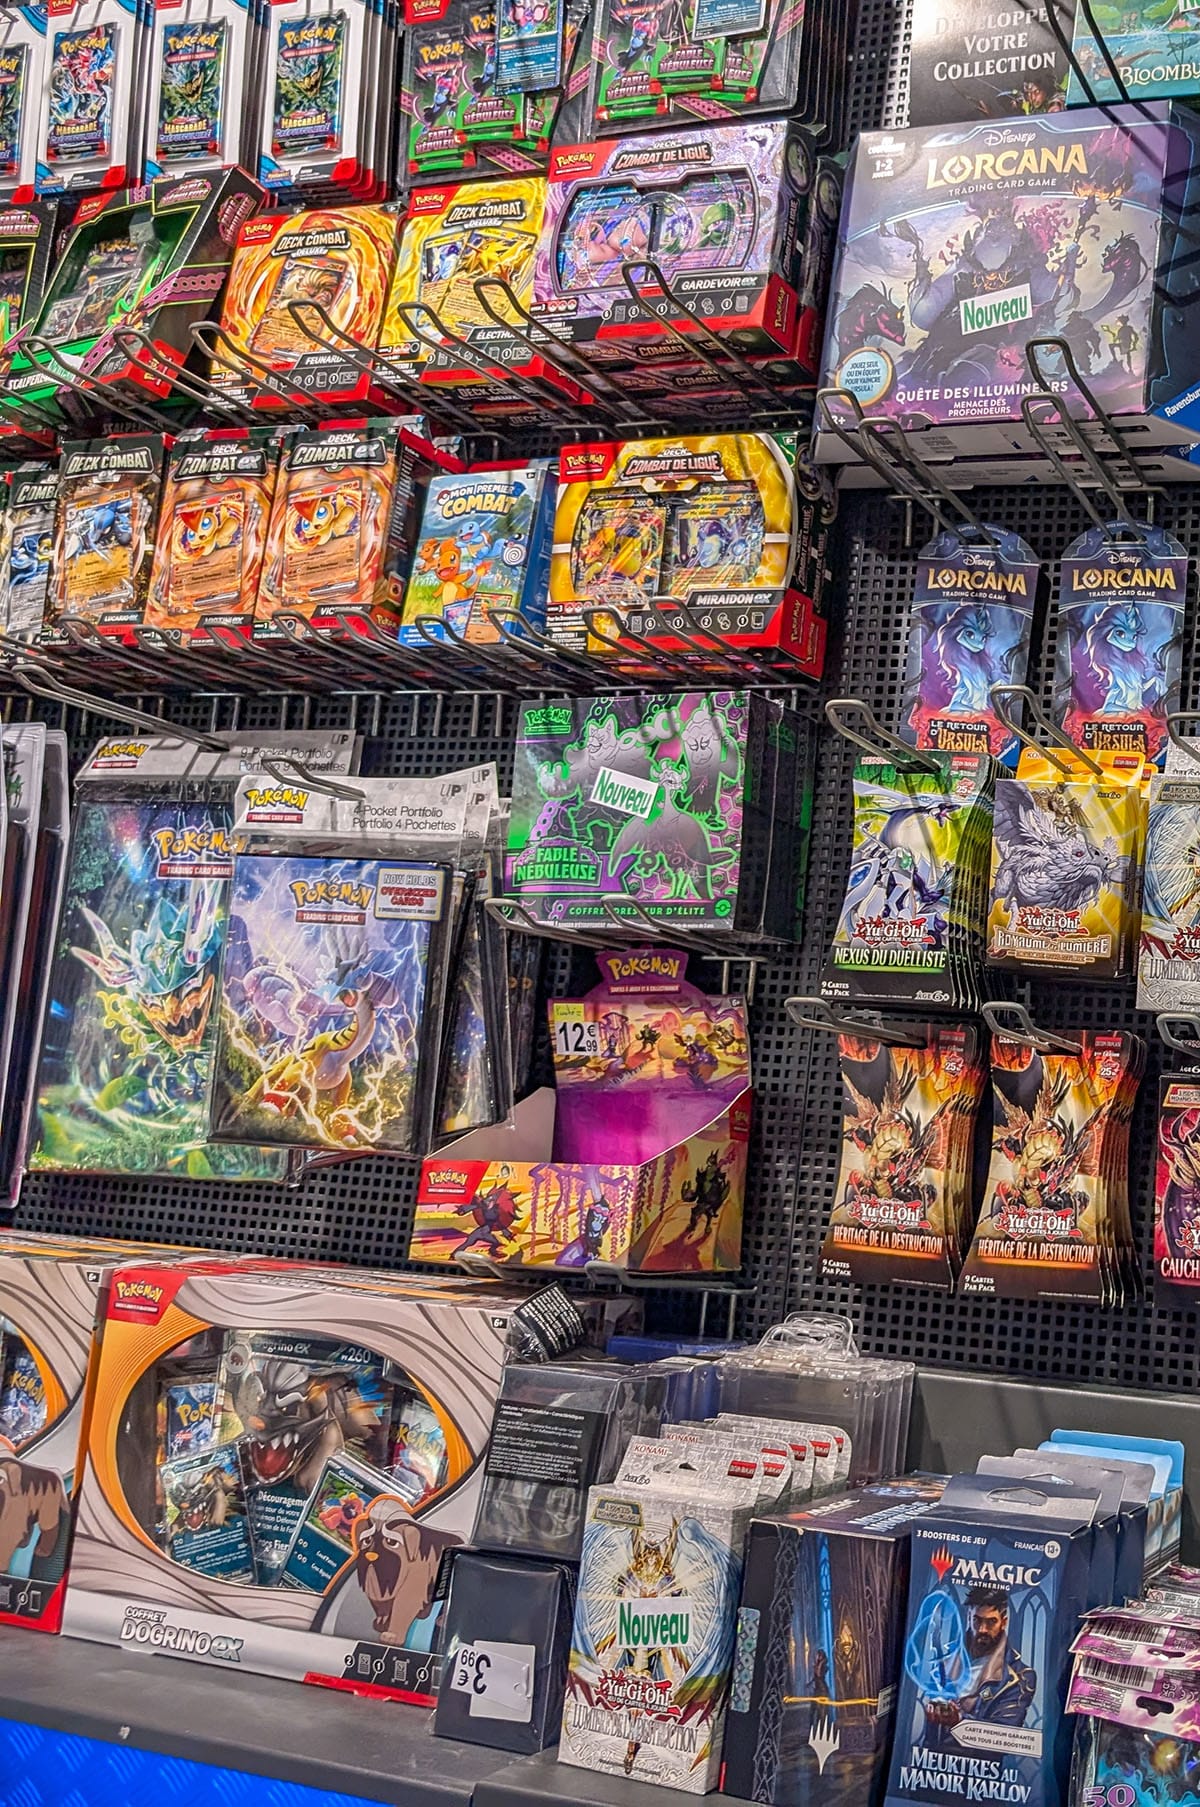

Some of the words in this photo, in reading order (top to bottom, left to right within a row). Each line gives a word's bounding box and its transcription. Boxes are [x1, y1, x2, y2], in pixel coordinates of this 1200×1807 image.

[963, 32, 1028, 54] VOTRE
[676, 48, 703, 61] FABLE
[933, 51, 1057, 81] COLLECTION
[984, 129, 1036, 146] Disney
[615, 150, 660, 170] COMBAT
[661, 149, 678, 163] DE
[678, 143, 712, 162] LIGUE
[927, 143, 1088, 190] LORCANA
[949, 183, 993, 196] TRADING
[997, 180, 1024, 190] CARD
[1028, 178, 1057, 188] GAME
[450, 205, 483, 222] DECK
[485, 201, 521, 218] COMBAT
[280, 233, 310, 251] DECK
[311, 230, 347, 247] COMBAT
[680, 277, 741, 291] GARDEVOIR
[963, 294, 1028, 328] Nouveau
[895, 386, 940, 404] QUÊTE
[943, 385, 971, 399] DES
[953, 401, 985, 409] MENACE
[987, 399, 1006, 407] DES
[948, 405, 1011, 416] PROFONDEURS
[69, 453, 100, 472] DECK
[101, 451, 148, 469] COMBAT
[293, 443, 354, 464] COMBAT
[179, 456, 238, 477] COMBAT
[626, 458, 670, 475] COMBAT
[670, 458, 686, 471] DE
[685, 454, 720, 471] LIGUE
[449, 486, 477, 499] MON
[477, 482, 515, 494] PREMIER
[441, 495, 516, 518] COMBAT
[928, 567, 1027, 596] LORCANA
[1072, 567, 1176, 591] LORCANA
[696, 592, 752, 605] MIRAIDON
[946, 720, 988, 732] RETOUR
[1099, 721, 1145, 733] RETOUR
[290, 747, 334, 758] Portfolio
[598, 770, 651, 813] Nouveau
[354, 805, 397, 817] 4-Pocket
[401, 806, 443, 817] Portfolio
[353, 818, 393, 830] Portfolio
[405, 818, 457, 831] Pochettes
[537, 846, 579, 863] FABLE
[517, 861, 597, 882] NÉBULEUSE
[835, 946, 862, 962] NEXUS
[863, 949, 884, 964] DU
[887, 950, 947, 969] DUELLISTE
[860, 1203, 922, 1222] Yu-Gi-Oh!
[833, 1226, 864, 1246] HÉRITAGE
[865, 1231, 879, 1246] DE
[879, 1234, 890, 1247] LA
[890, 1233, 943, 1254] DESTRUCTION
[917, 1528, 922, 1537] 3
[923, 1530, 958, 1541] BOOSTERS
[961, 1534, 970, 1542] DE
[972, 1536, 987, 1545] JEU
[1014, 1540, 1045, 1552] FRANÇAIS
[952, 1557, 1042, 1587] MAGIC
[952, 1578, 965, 1586] THE
[968, 1579, 1011, 1592] GATHERING
[125, 1606, 167, 1622] COFFRET
[618, 1601, 690, 1647] Nouveau
[120, 1619, 211, 1656] DOGRINO
[911, 1746, 1000, 1779] MEURTRES
[1000, 1766, 1018, 1782] AU
[899, 1766, 966, 1798] MANOIR
[966, 1779, 1032, 1805] KARLOV
